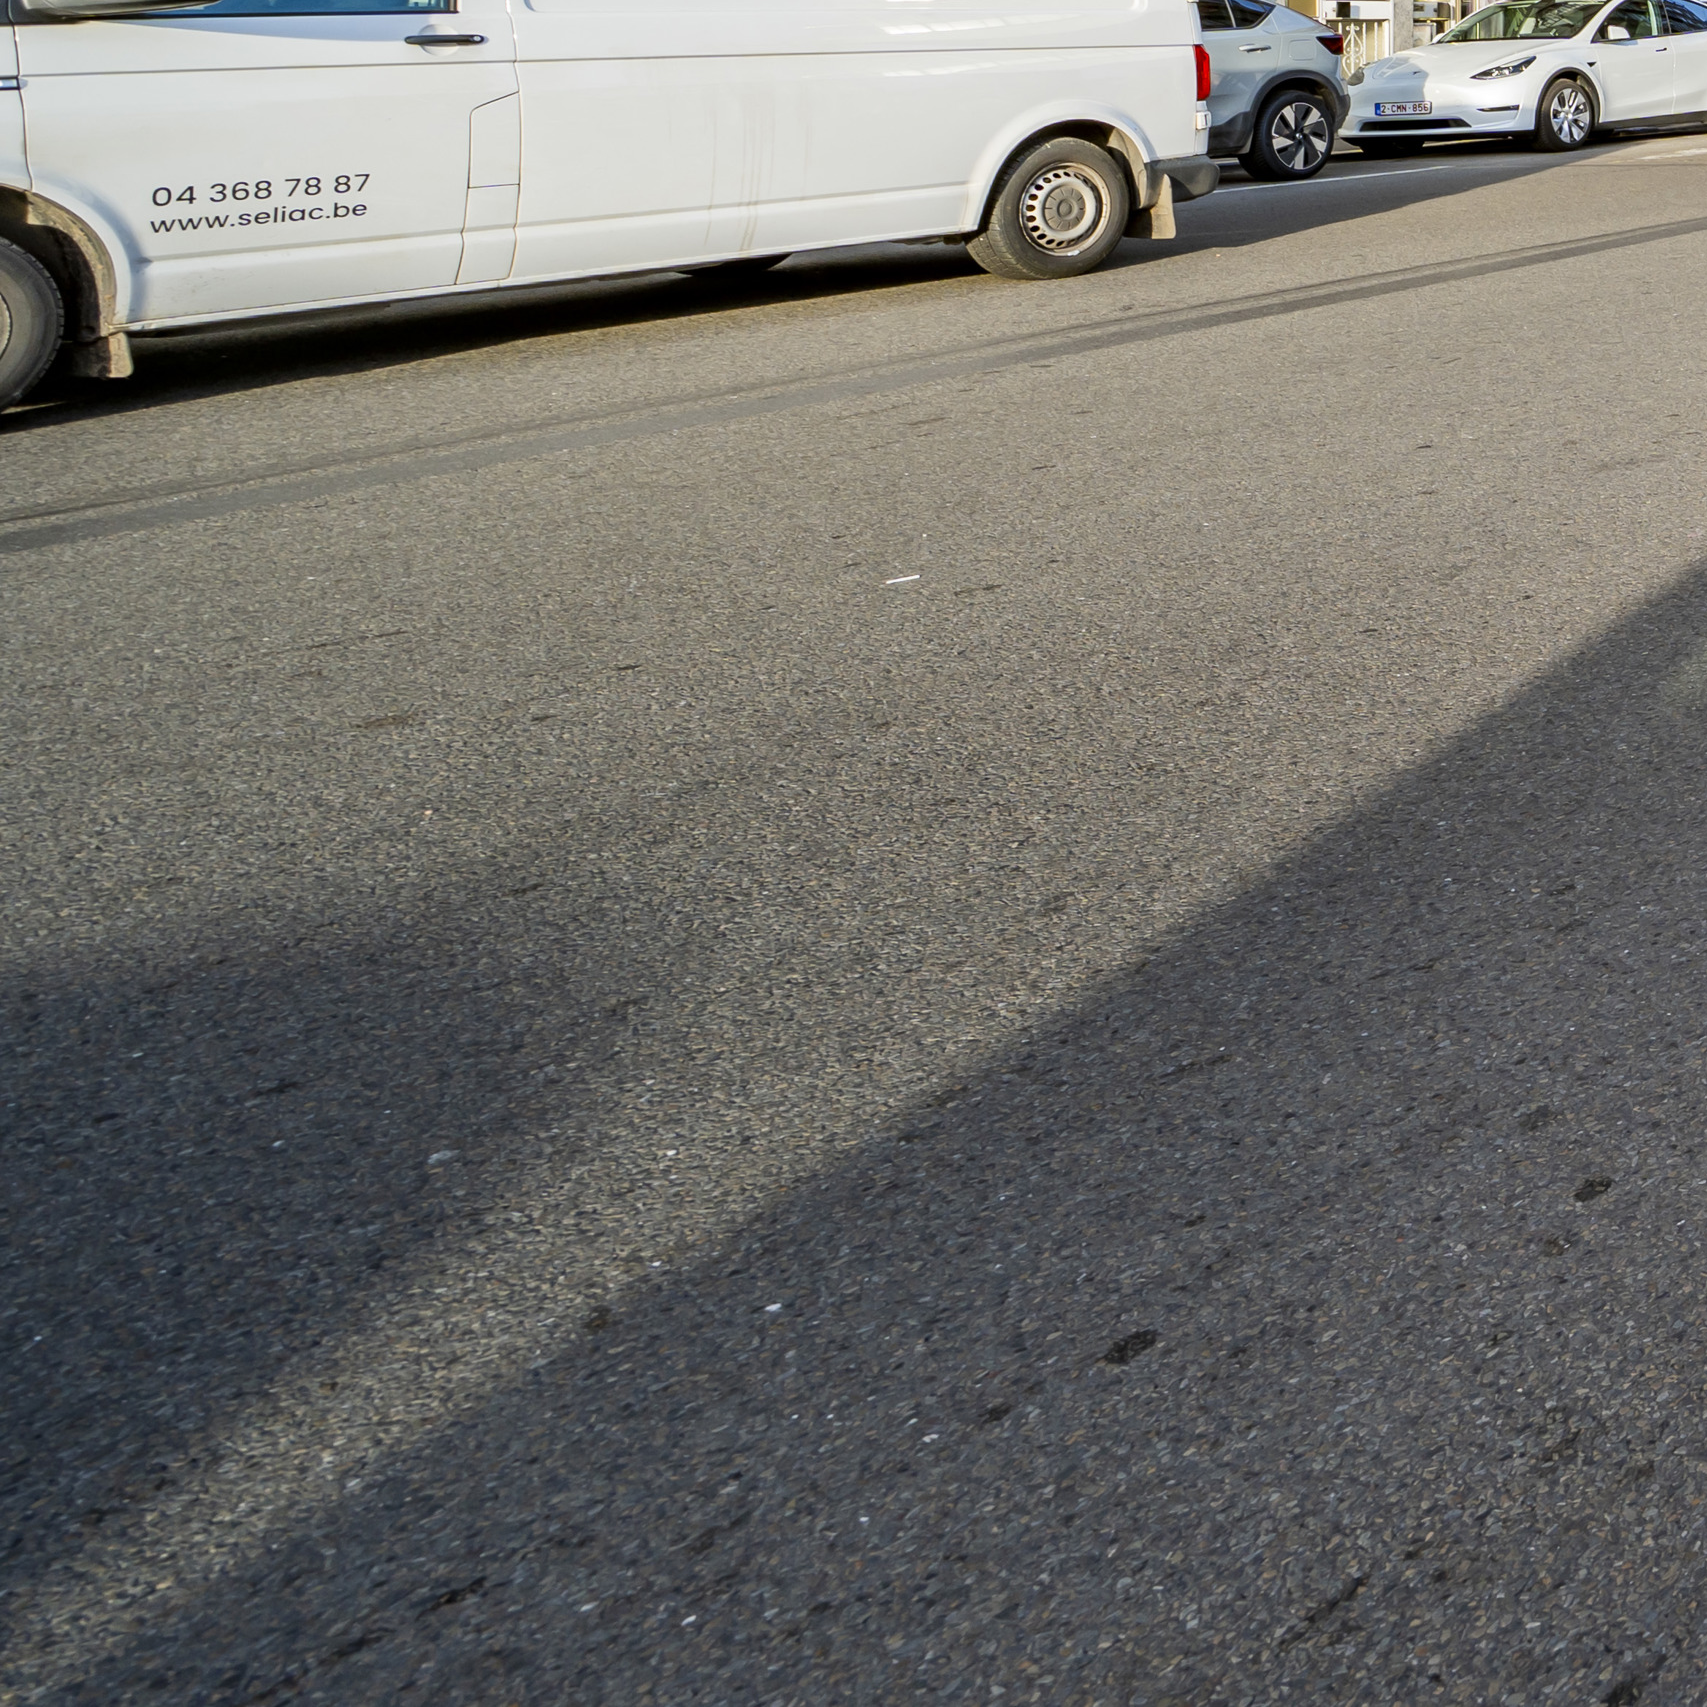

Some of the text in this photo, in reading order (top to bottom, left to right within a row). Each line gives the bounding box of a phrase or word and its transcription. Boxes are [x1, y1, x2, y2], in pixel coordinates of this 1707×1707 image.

[151, 173, 371, 207] 04 368 78 87
[150, 202, 368, 234] www.seliac.be
